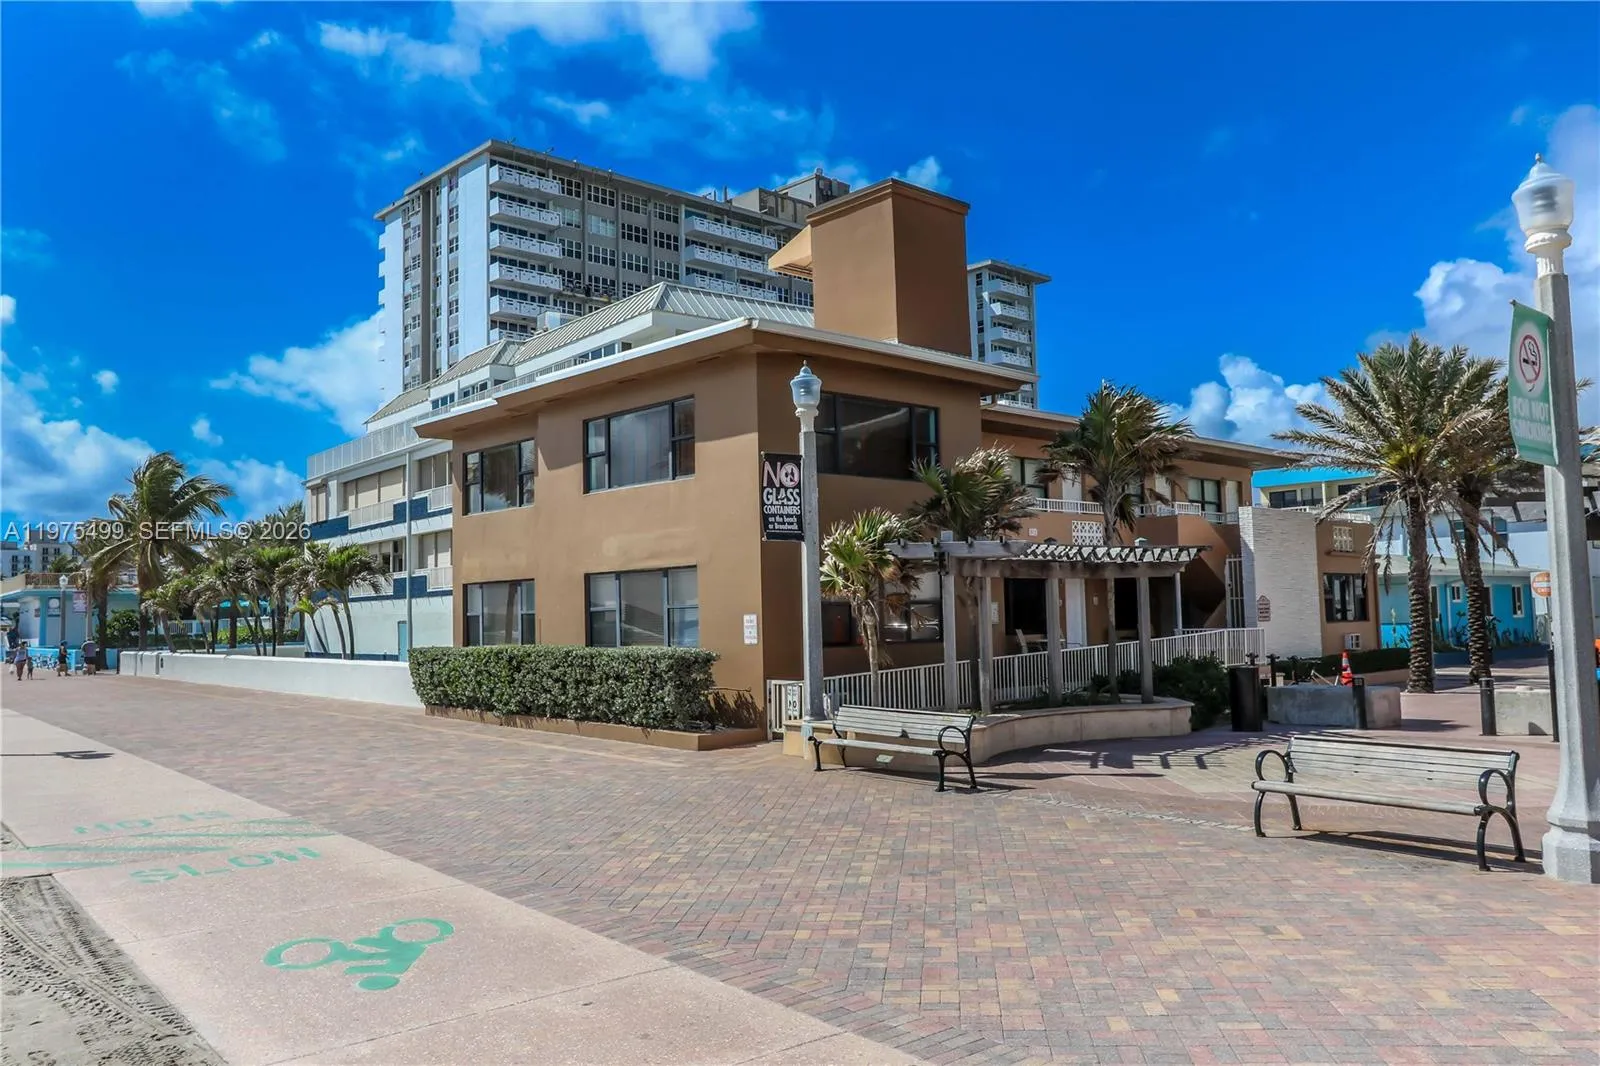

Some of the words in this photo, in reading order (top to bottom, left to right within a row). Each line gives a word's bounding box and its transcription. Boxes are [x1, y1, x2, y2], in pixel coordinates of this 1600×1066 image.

[1513, 396, 1529, 420] FOR
[1531, 401, 1549, 422] NOT
[1513, 418, 1552, 443] SMOKING
[763, 461, 800, 488] NO
[763, 487, 801, 506] GLASS
[763, 505, 801, 515] CONTAINERS
[775, 515, 783, 523] the
[784, 515, 797, 523] beach
